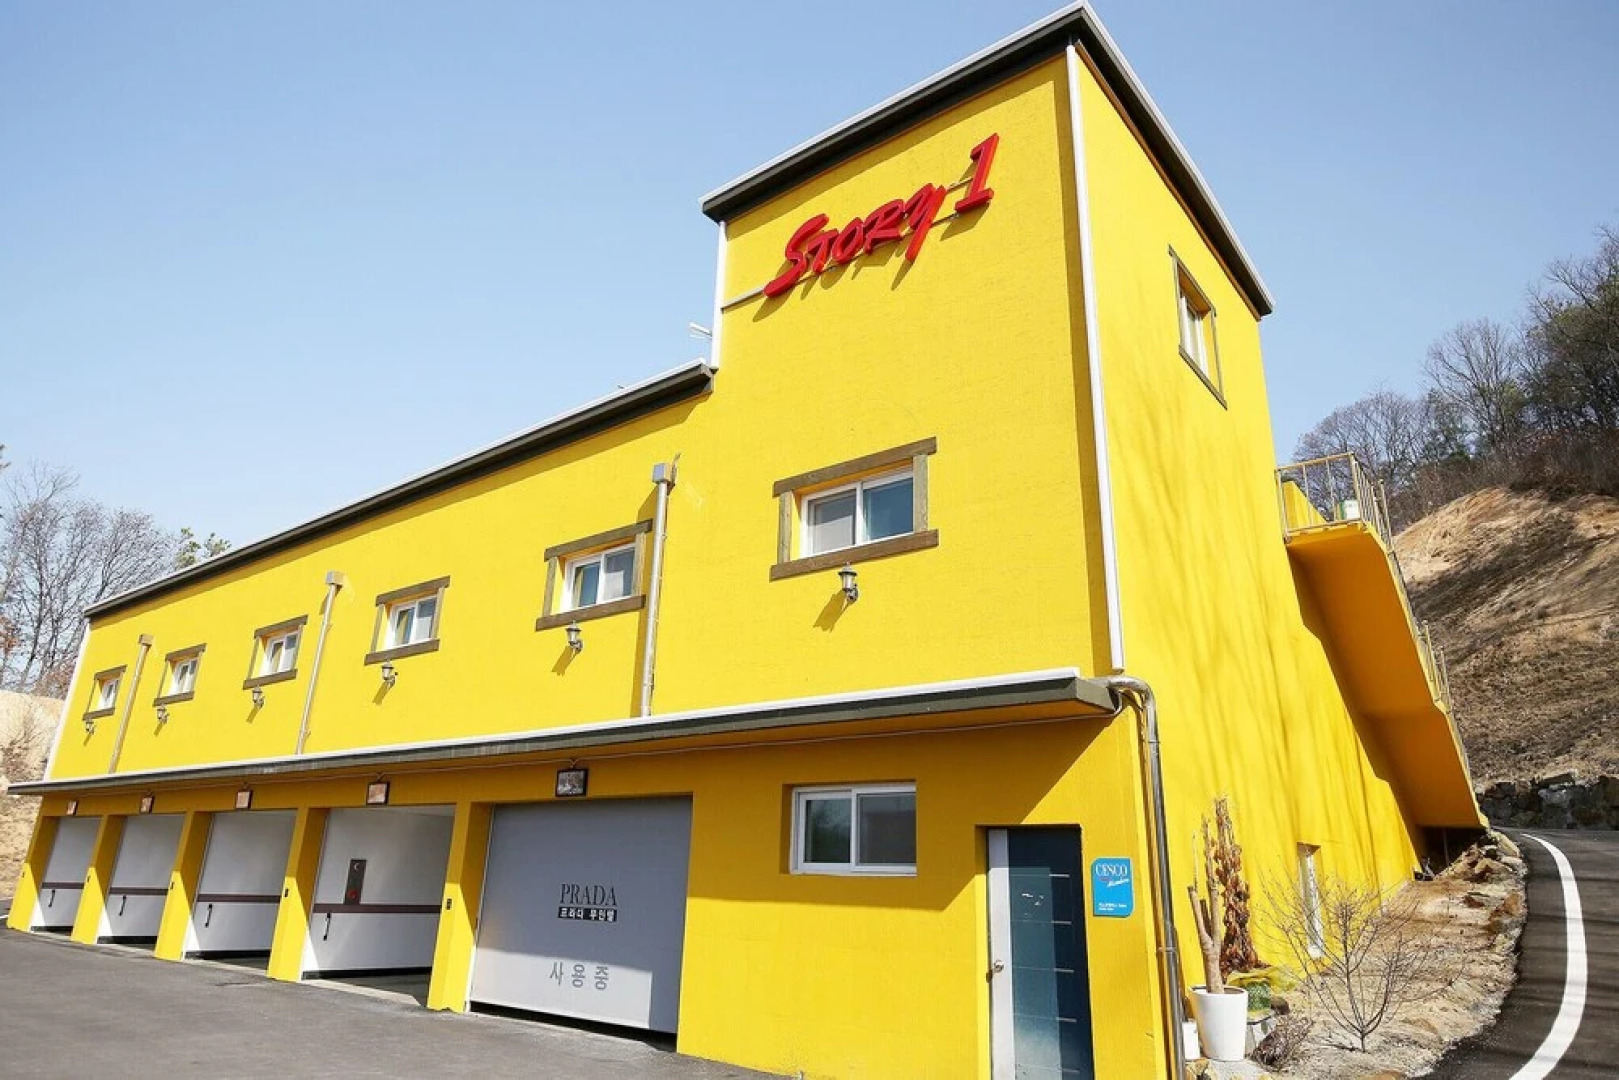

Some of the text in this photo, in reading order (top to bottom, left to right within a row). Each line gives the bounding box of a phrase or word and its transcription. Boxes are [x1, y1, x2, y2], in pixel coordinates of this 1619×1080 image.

[954, 132, 1000, 213] 1
[1095, 863, 1127, 877] CESCO
[559, 883, 617, 906] PRADA
